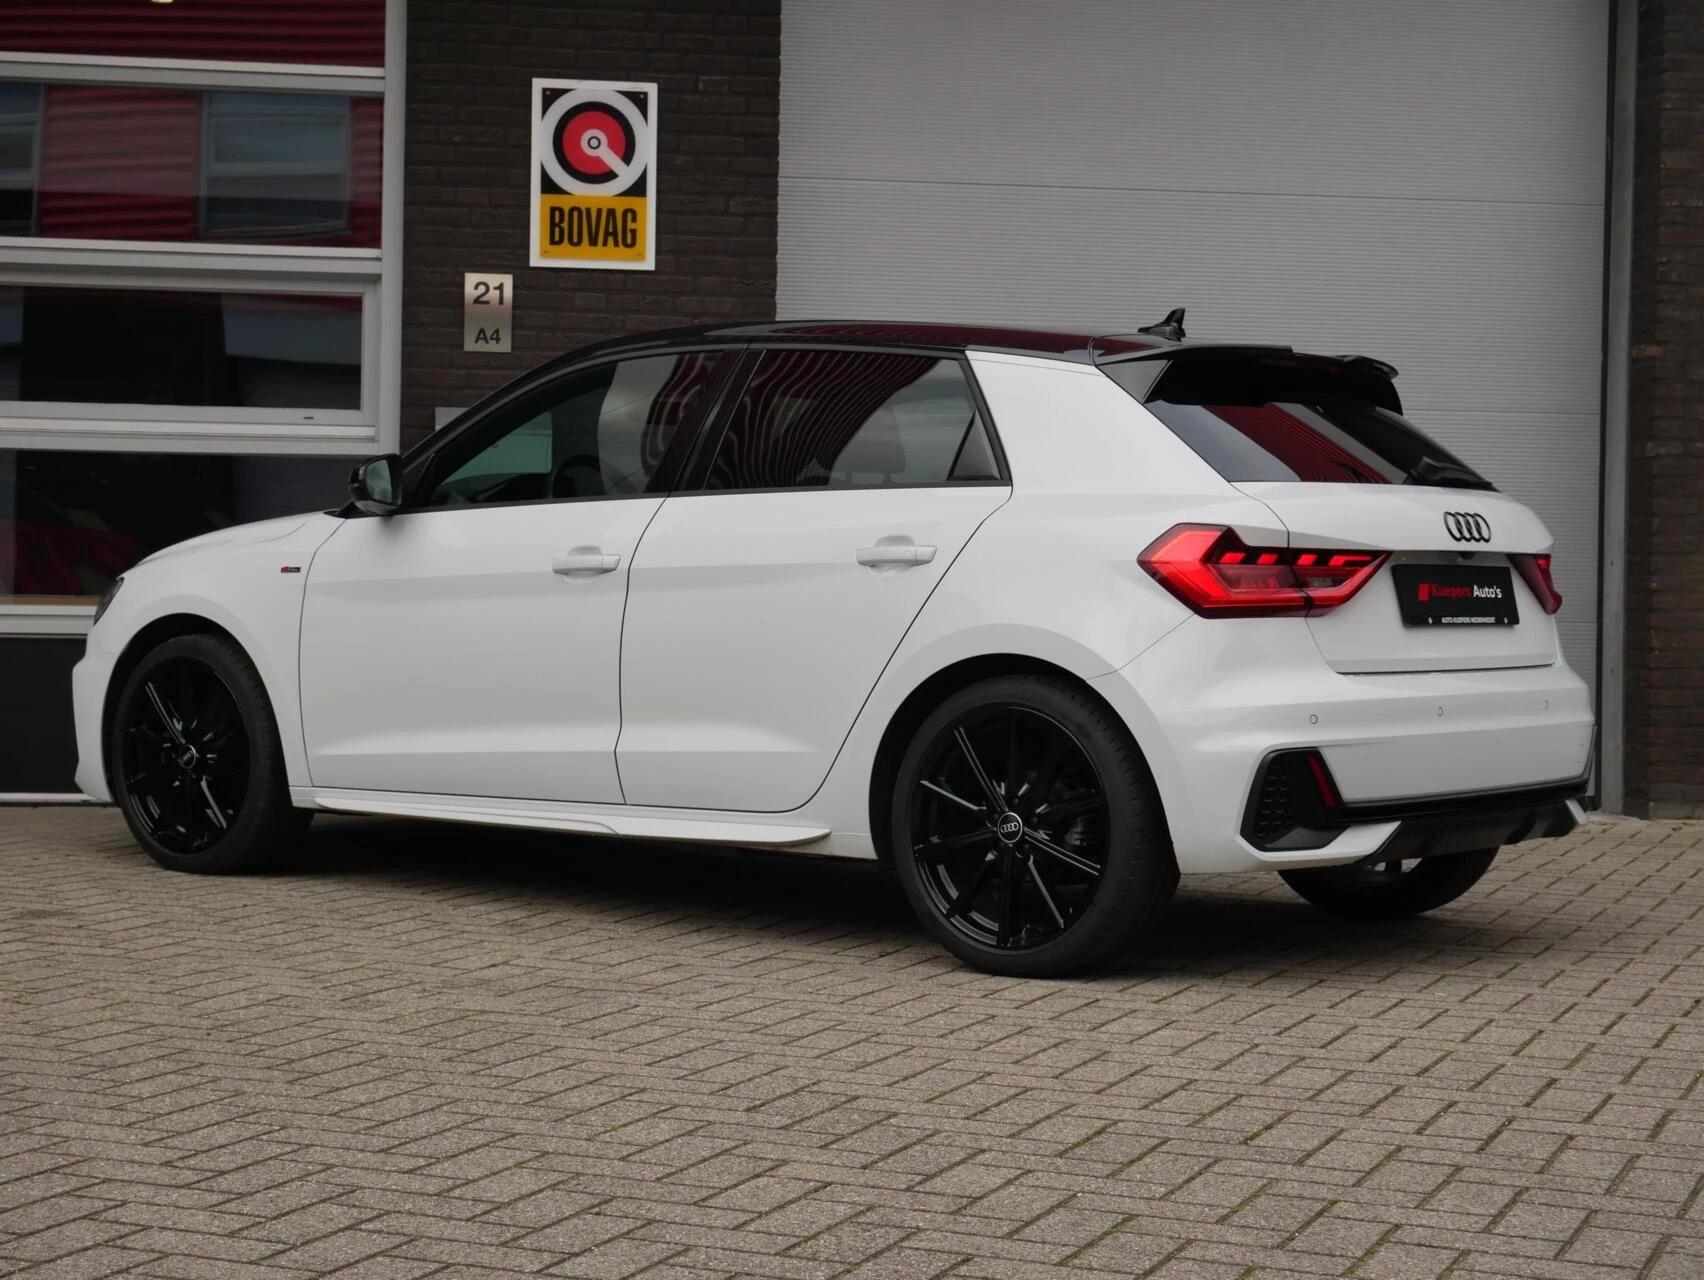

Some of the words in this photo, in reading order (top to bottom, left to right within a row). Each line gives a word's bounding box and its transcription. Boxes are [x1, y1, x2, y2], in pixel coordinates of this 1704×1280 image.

[549, 206, 637, 248] BOVAG
[473, 281, 505, 306] 21
[474, 327, 502, 344] A4
[1473, 585, 1502, 598] Auto's
